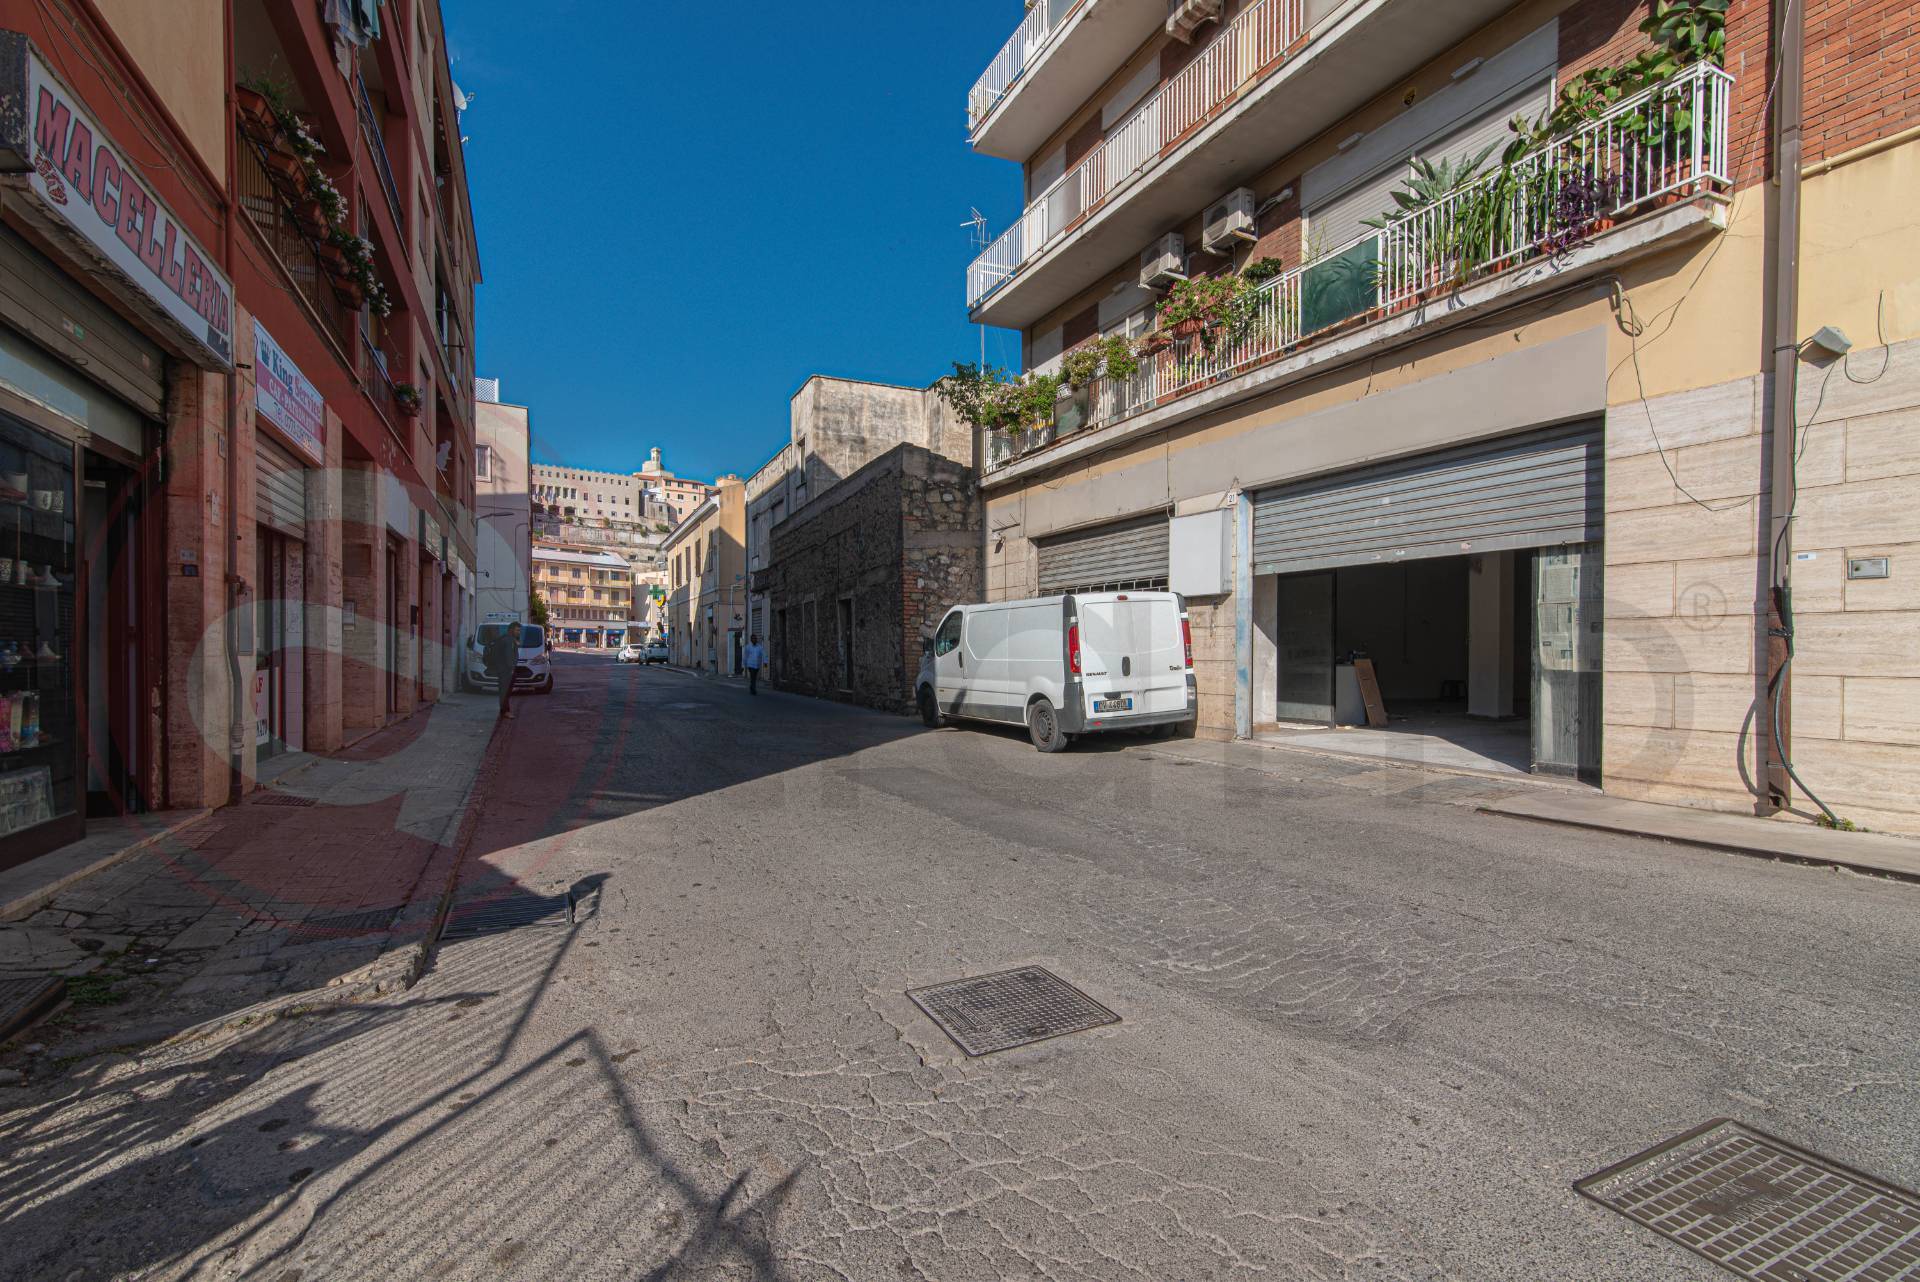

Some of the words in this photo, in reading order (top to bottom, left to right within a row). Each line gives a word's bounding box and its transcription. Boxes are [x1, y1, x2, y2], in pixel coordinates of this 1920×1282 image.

[36, 84, 229, 335] MACELLERIA
[272, 348, 293, 396] King
[294, 375, 321, 417] Service
